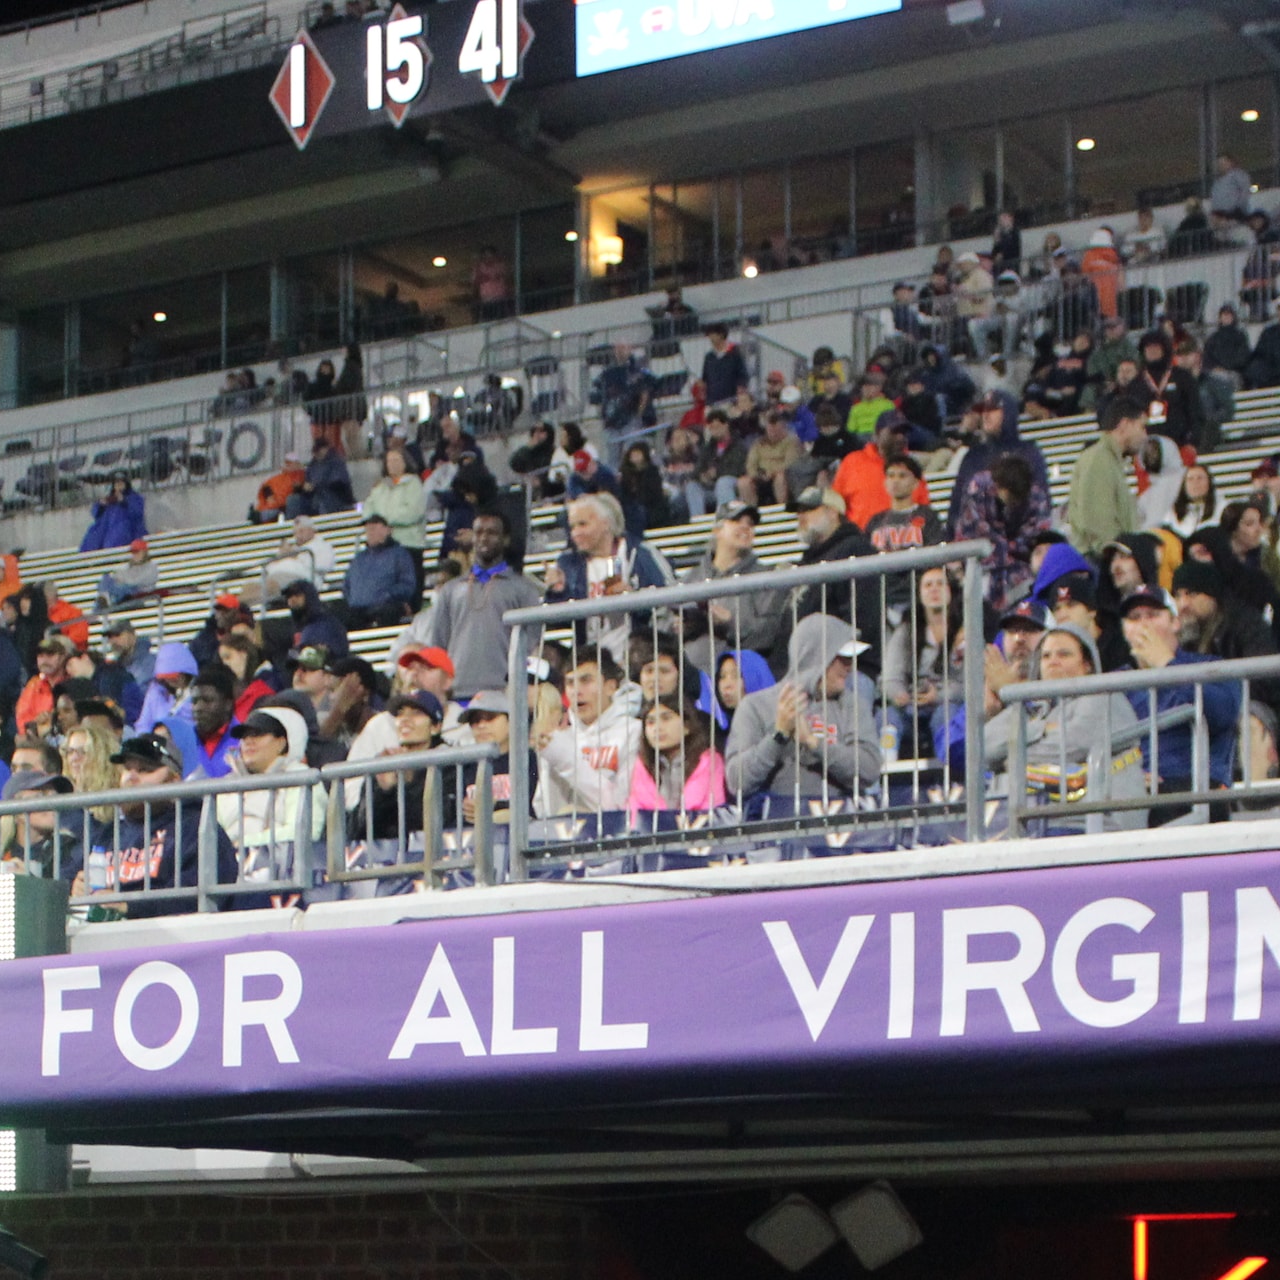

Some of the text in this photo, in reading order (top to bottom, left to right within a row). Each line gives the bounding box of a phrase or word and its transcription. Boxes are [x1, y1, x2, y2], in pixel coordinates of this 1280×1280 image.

[367, 16, 423, 110] 15
[458, 0, 517, 82] 41
[42, 950, 304, 1077] FOR
[388, 930, 649, 1060] ALL
